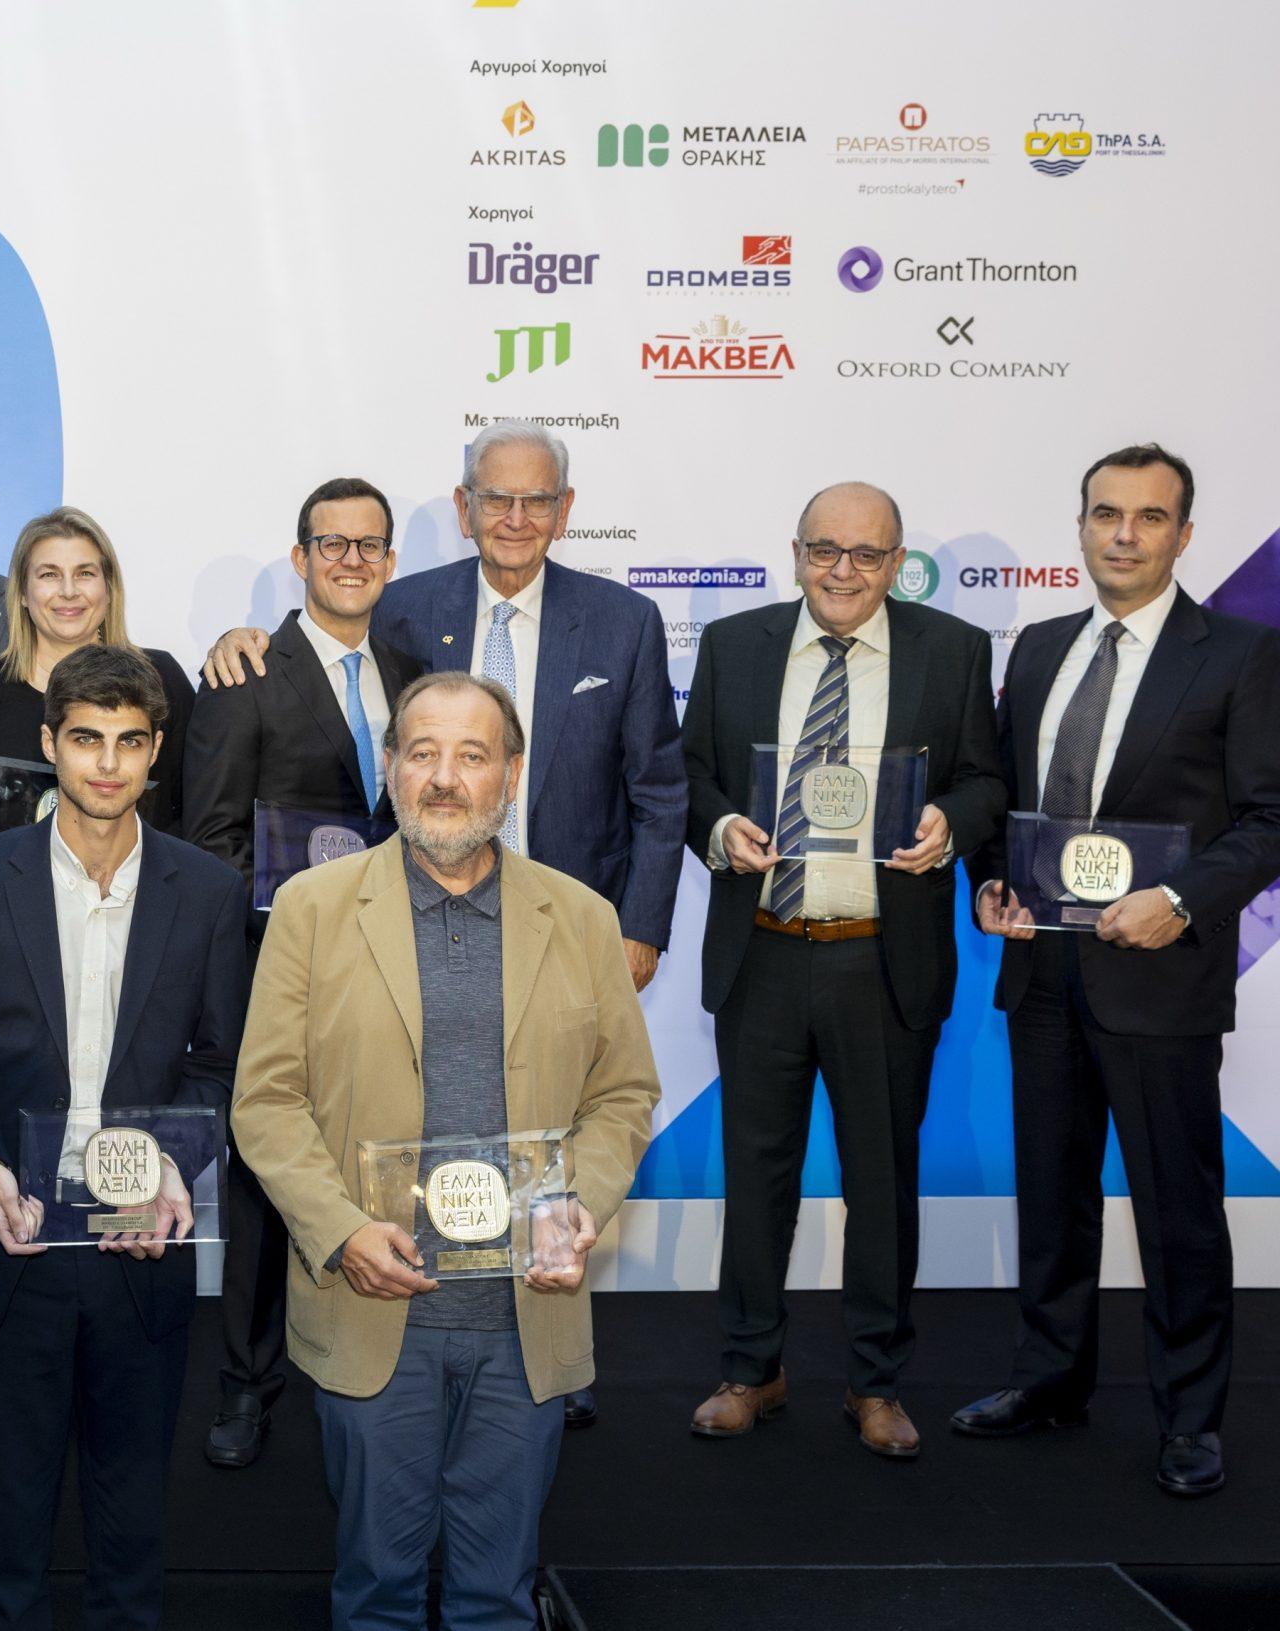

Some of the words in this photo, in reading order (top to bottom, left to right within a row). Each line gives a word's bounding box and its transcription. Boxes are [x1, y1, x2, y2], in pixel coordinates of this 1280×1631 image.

[470, 60, 536, 76] Αργυροί
[542, 60, 606, 76] Χορηγοί
[684, 127, 806, 142] ΜΕΤΑΛΛΕΙΑ
[1096, 134, 1132, 147] ThPA
[1138, 134, 1166, 147] S.A.
[837, 136, 990, 152] PAPASTRATOS
[471, 150, 565, 165] AKRITAS
[683, 150, 765, 165] ΘΡΑΚΗΣ
[858, 184, 958, 195] #prostokalytero
[469, 206, 533, 222] Χορηγοί
[469, 242, 600, 293] Dräger
[894, 258, 963, 281] Grant
[967, 258, 1076, 281] Thornton
[642, 343, 795, 370] ΜΑΚΒΕΛ
[464, 414, 487, 426] Με
[629, 569, 765, 586] emakedonia.gr
[960, 567, 1078, 588] GRTIMES
[813, 775, 856, 787] ΕΛΛΗ
[813, 790, 854, 802] ΝΙΚΗ
[320, 834, 357, 850] ΕΛΛΗ
[1075, 845, 1119, 858] ΕΛΛΗ
[1075, 861, 1119, 875] ΝΙΚΗ
[98, 1141, 147, 1157] ΕΛΛΗ
[99, 1159, 147, 1174] ΝΙΚΗ
[441, 1172, 491, 1190] ΕΛΛΗ
[441, 1191, 492, 1209] ΝΙΚΗ
